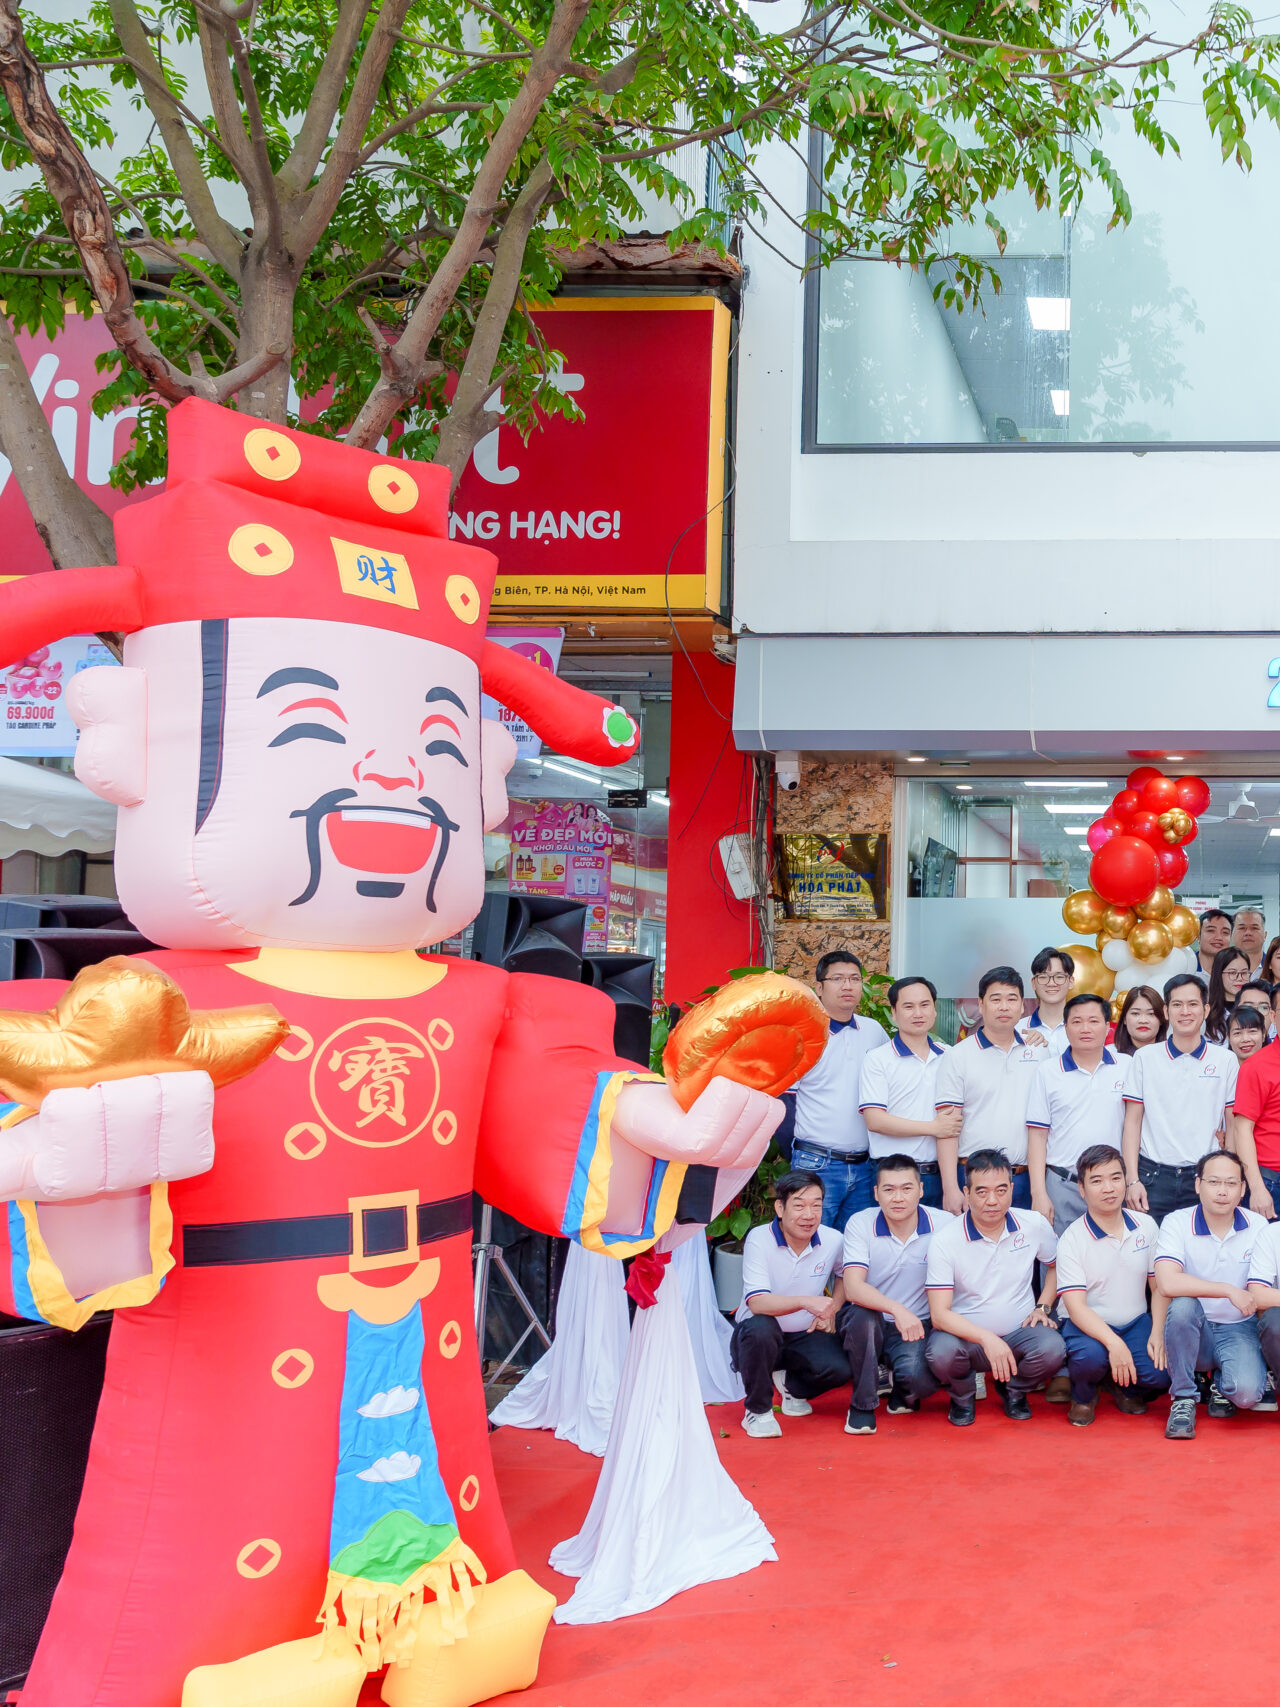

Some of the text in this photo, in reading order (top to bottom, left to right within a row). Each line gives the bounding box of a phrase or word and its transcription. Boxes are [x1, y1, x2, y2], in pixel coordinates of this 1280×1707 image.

[448, 509, 621, 545] NG HẠNG!
[356, 554, 398, 595] 财
[504, 586, 531, 597] Biên,
[535, 586, 551, 595] TP.
[572, 585, 594, 597] Nội,
[597, 585, 618, 597] Việt
[622, 586, 646, 595] Nam
[7, 706, 55, 719] 69.900đ
[541, 828, 576, 844] ĐẸP
[580, 828, 612, 845] MỚI
